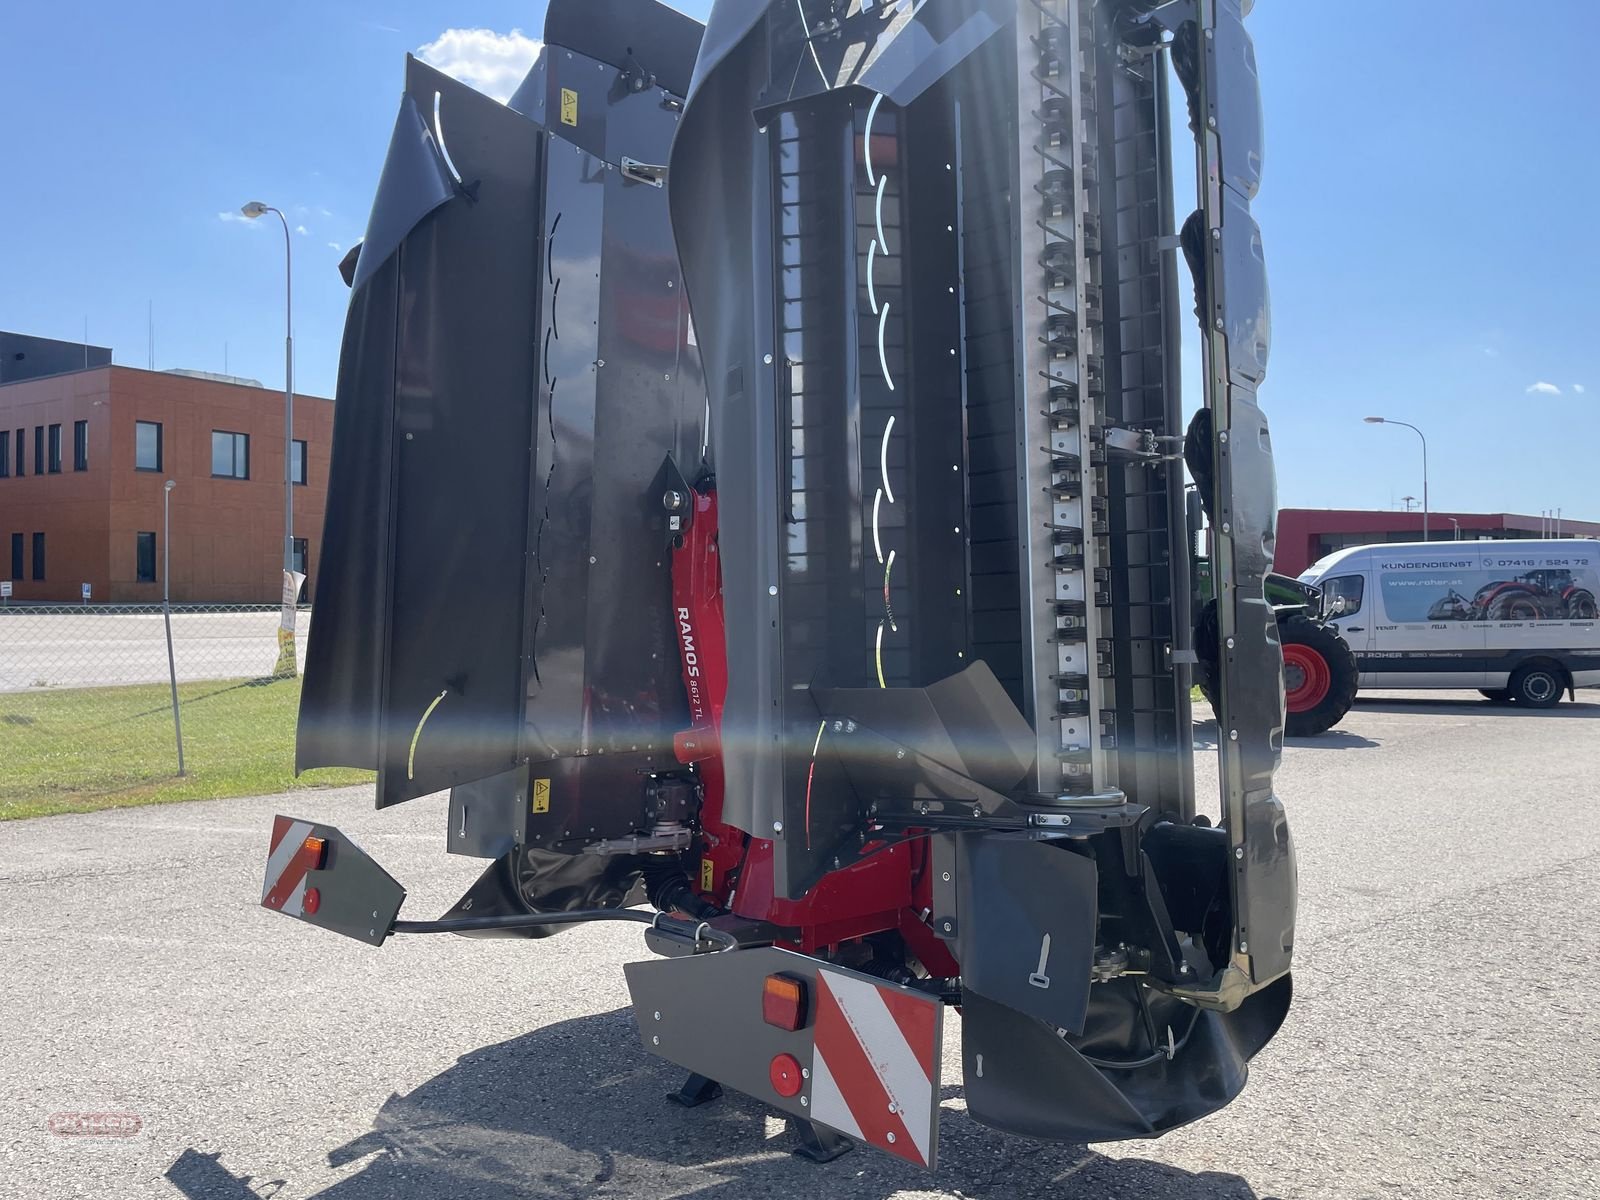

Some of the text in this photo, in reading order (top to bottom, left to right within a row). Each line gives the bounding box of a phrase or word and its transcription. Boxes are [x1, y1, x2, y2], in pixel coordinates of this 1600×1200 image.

[1381, 561, 1473, 570] KUNDENDIENST
[1498, 559, 1535, 567] 07416
[1546, 558, 1569, 566] 524
[1573, 558, 1589, 566] 72
[677, 607, 703, 720] RAMOS 8612 TL
